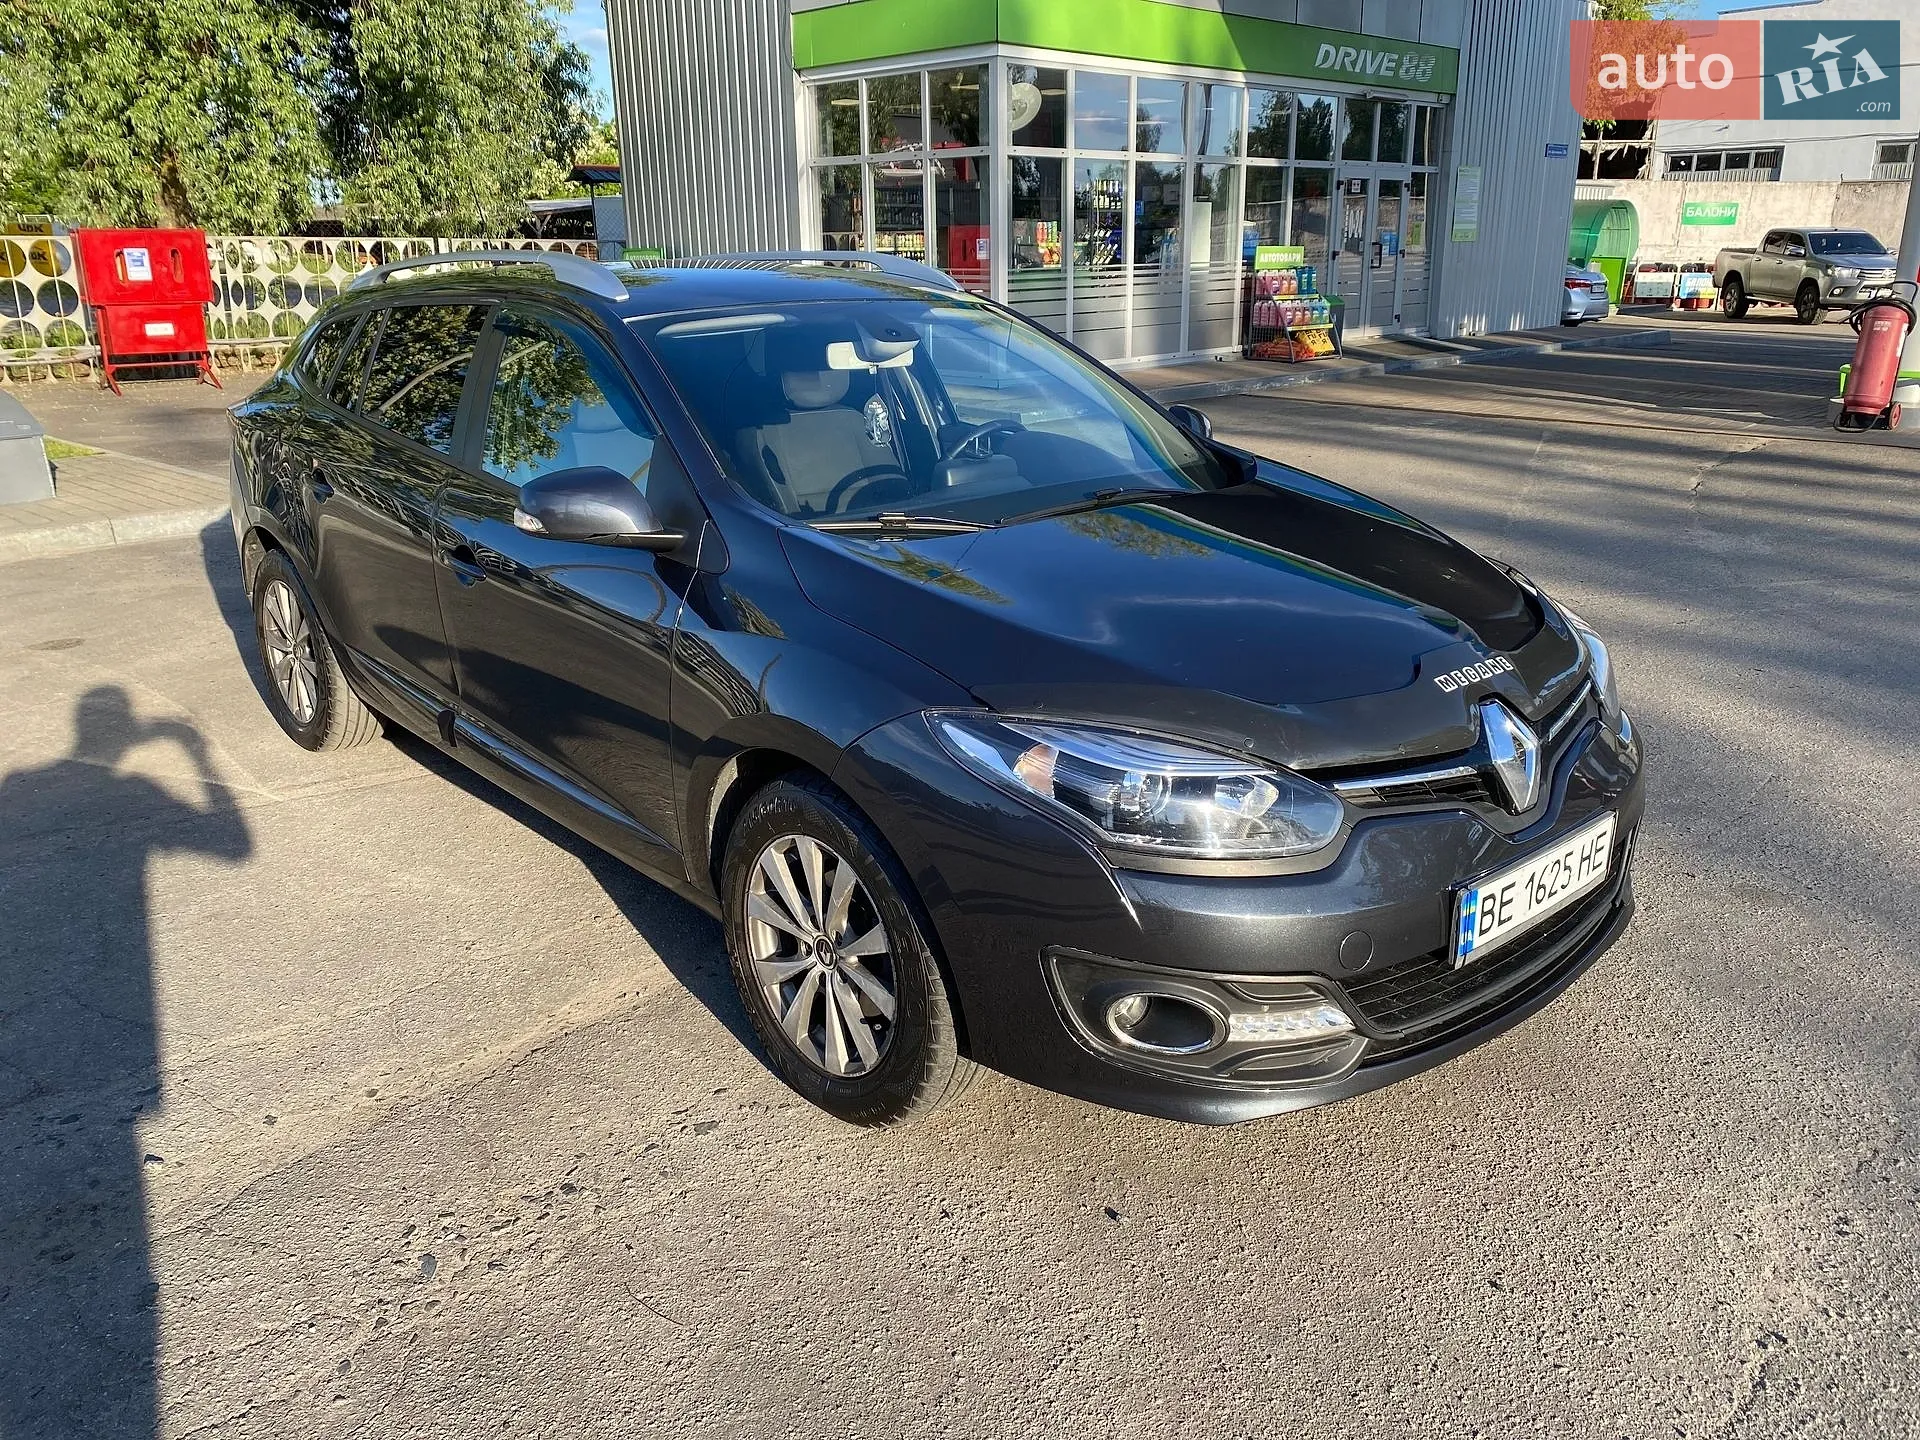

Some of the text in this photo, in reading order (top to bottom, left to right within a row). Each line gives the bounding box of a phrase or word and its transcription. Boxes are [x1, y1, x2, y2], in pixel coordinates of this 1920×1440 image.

[1686, 206, 1737, 217] БАЛОНИ
[1434, 656, 1514, 693] MEGANE
[1478, 830, 1608, 937] BE 1625 HE
[1460, 929, 1473, 945] UA
